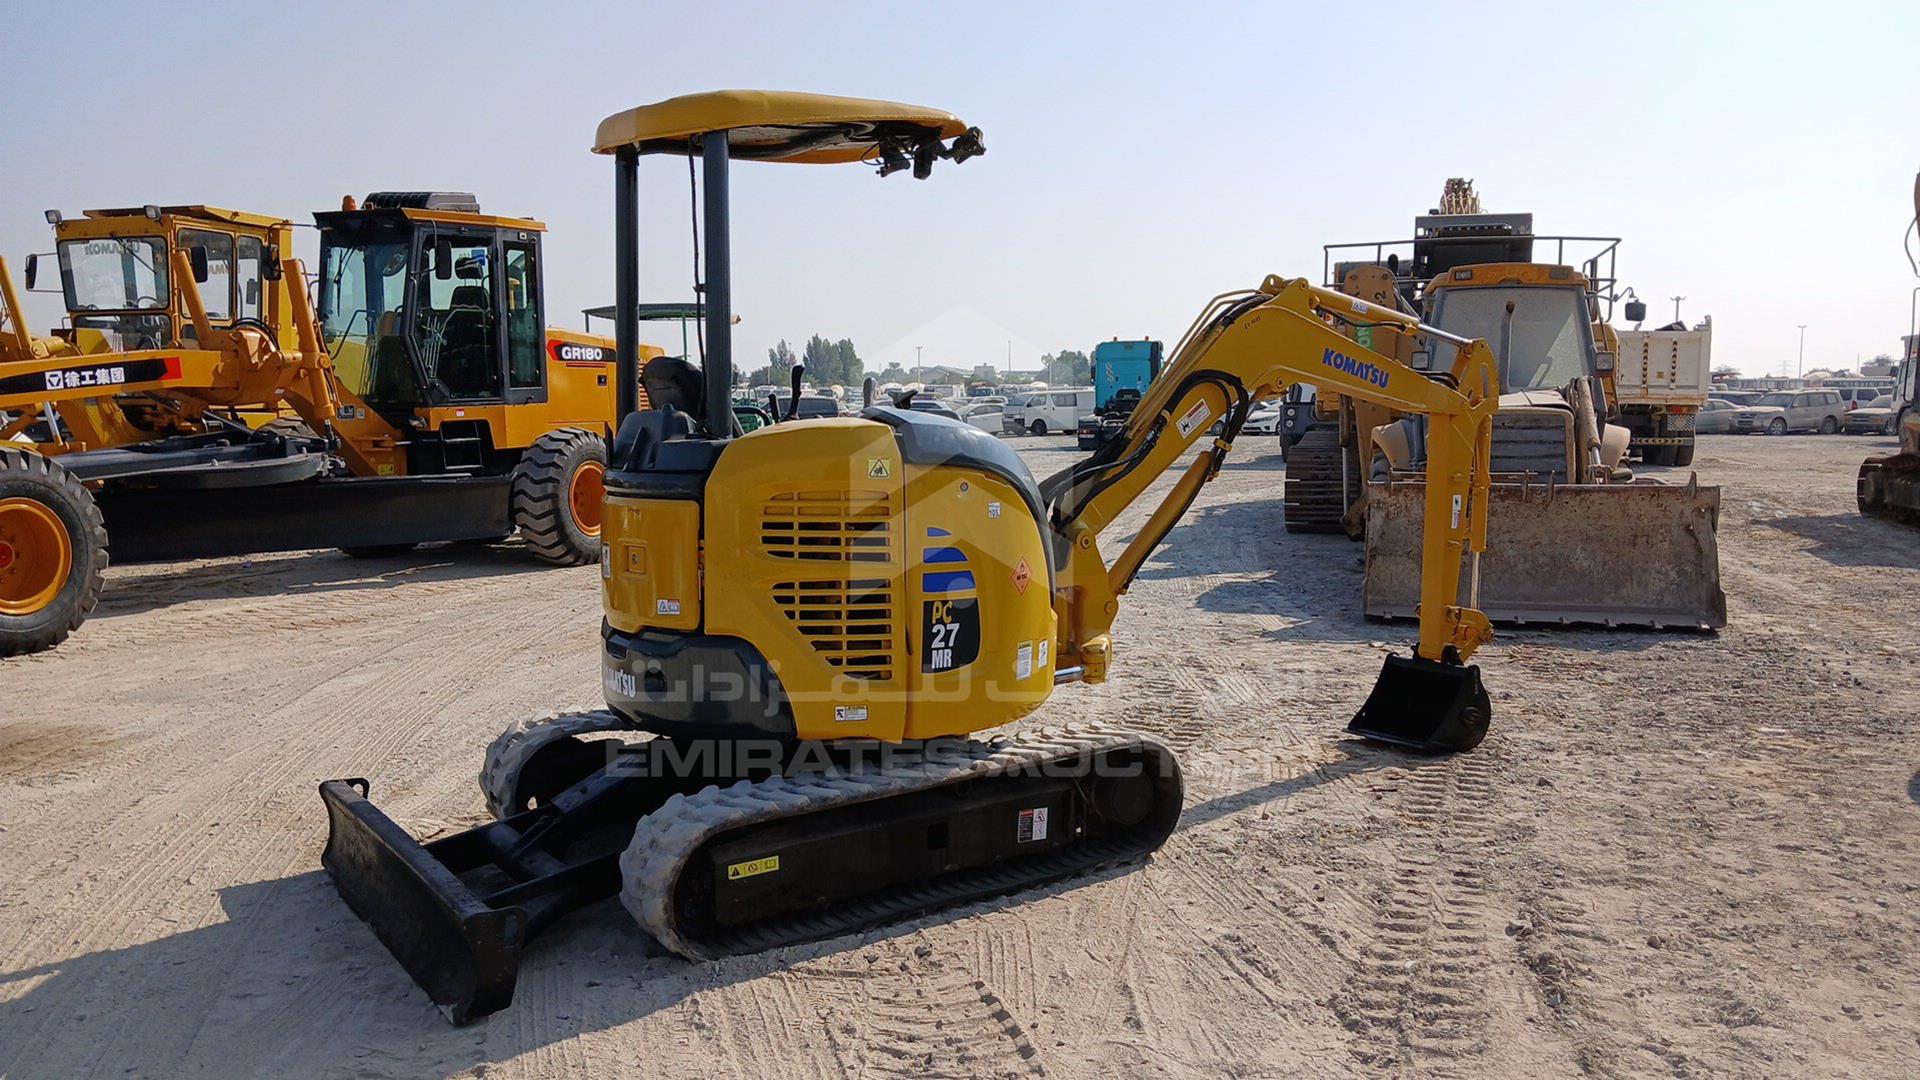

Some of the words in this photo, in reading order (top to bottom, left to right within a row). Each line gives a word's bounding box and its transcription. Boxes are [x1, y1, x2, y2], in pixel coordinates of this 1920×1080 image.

[85, 239, 140, 255] KOMAU
[561, 346, 603, 360] GR180
[65, 367, 125, 388] 徐工集团
[1322, 347, 1390, 388] KOMATSU
[932, 601, 953, 624] PC
[931, 623, 960, 649] 27
[931, 648, 952, 669] MR
[604, 666, 636, 698] MATSU
